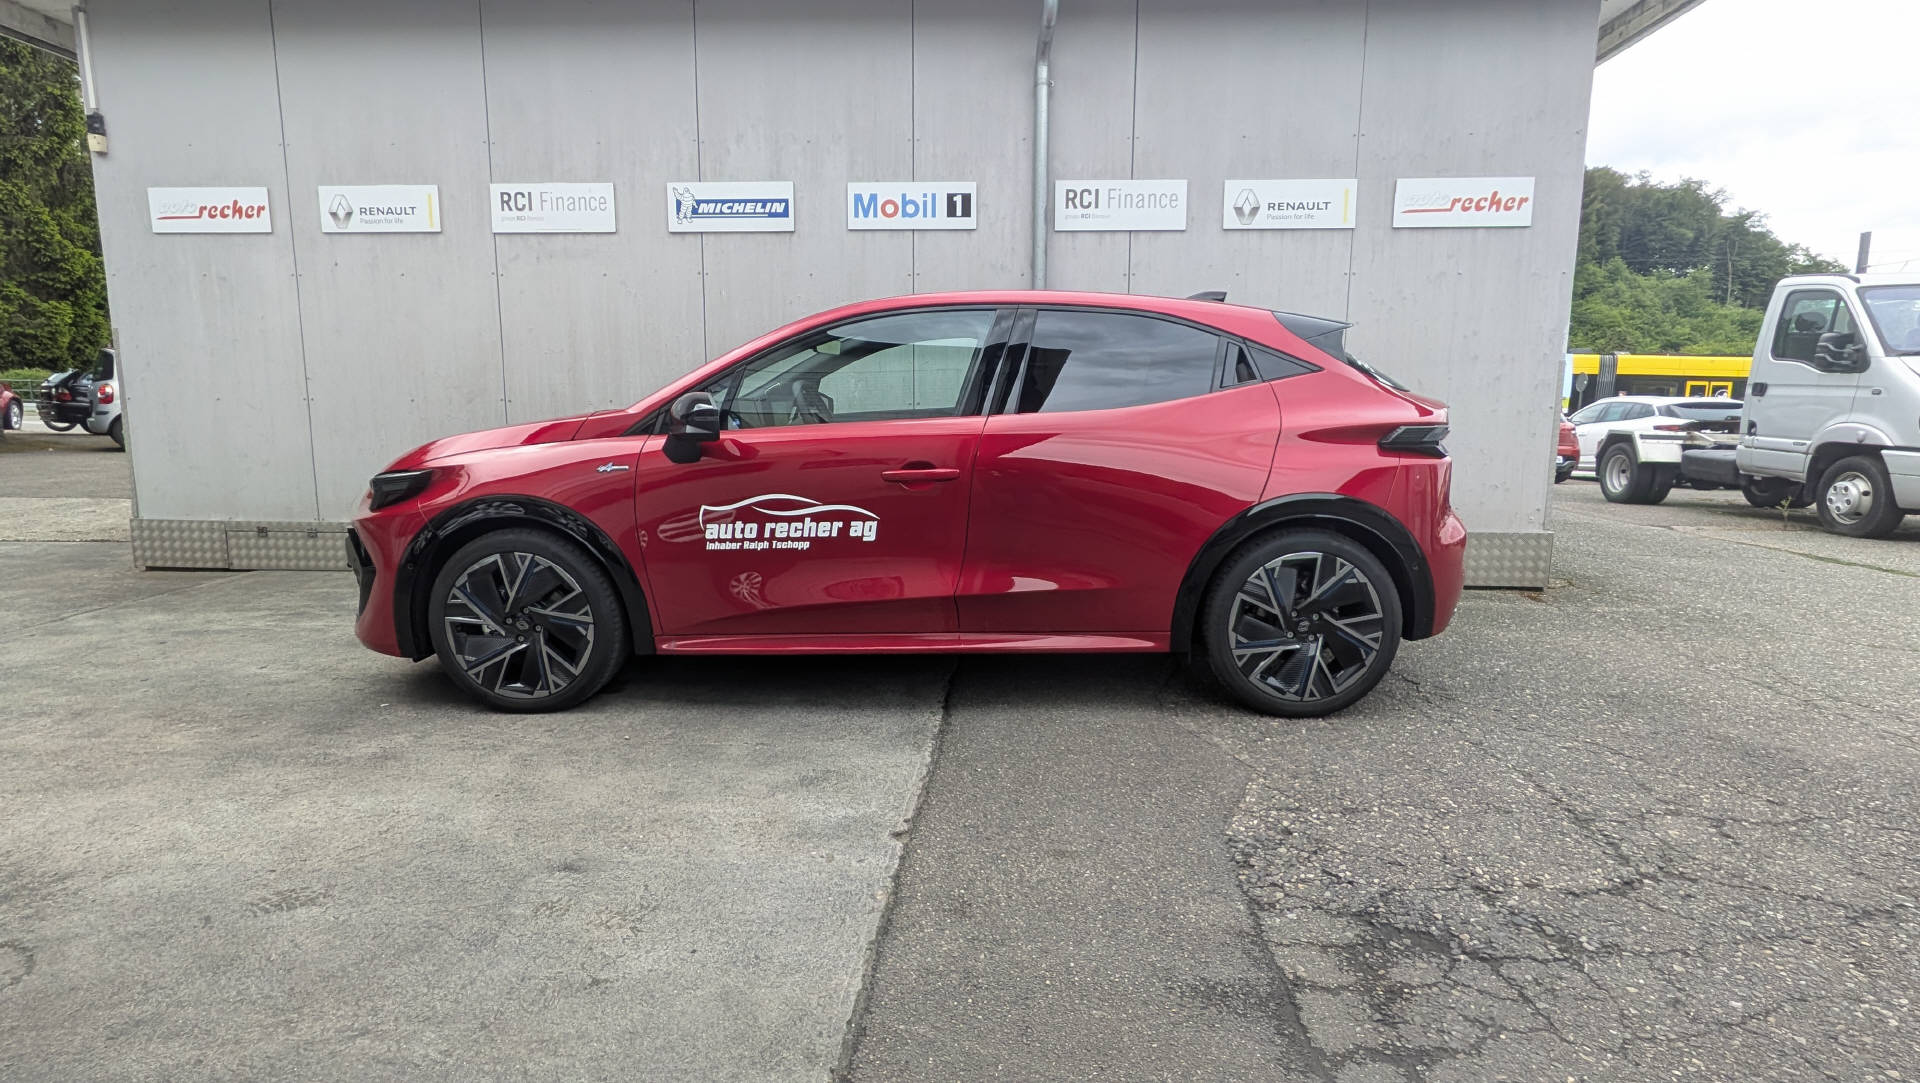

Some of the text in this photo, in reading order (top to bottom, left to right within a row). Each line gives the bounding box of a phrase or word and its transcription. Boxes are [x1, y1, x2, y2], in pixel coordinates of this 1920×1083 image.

[500, 191, 608, 212] RCI Finance
[697, 202, 786, 214] MICHELIN
[853, 192, 937, 219] Mobil
[1065, 188, 1180, 209] RCI Finance
[1267, 201, 1331, 211] RENAULT
[1450, 190, 1529, 213] recher
[199, 199, 266, 220] recher
[359, 206, 416, 216] RENAULT
[705, 517, 878, 542] auto recher ag
[706, 540, 810, 551] Inhaber Ralph Tschopp
